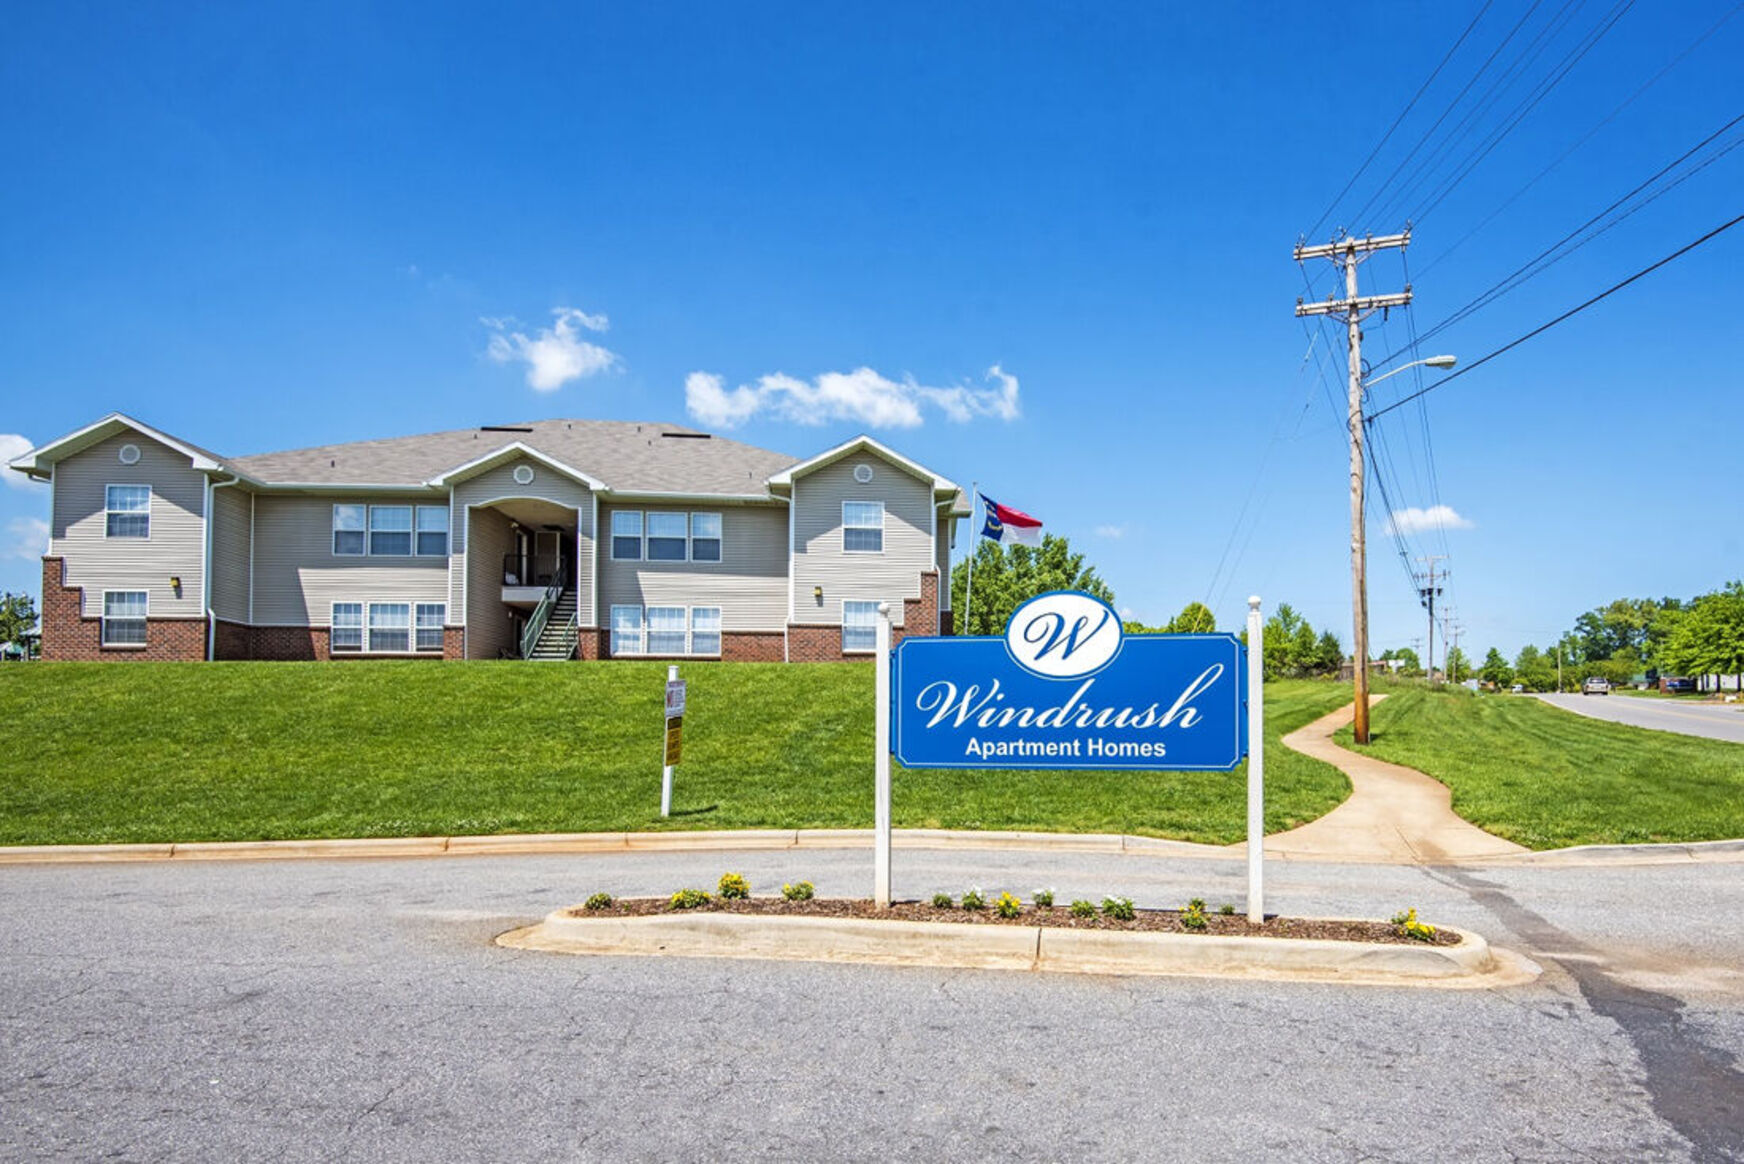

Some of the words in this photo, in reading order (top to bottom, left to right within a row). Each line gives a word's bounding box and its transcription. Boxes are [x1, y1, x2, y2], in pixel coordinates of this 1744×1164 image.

[1023, 609, 1108, 661] W
[916, 663, 1224, 729] Windrush
[965, 737, 1081, 759] Apartment
[1087, 737, 1166, 758] Homes
